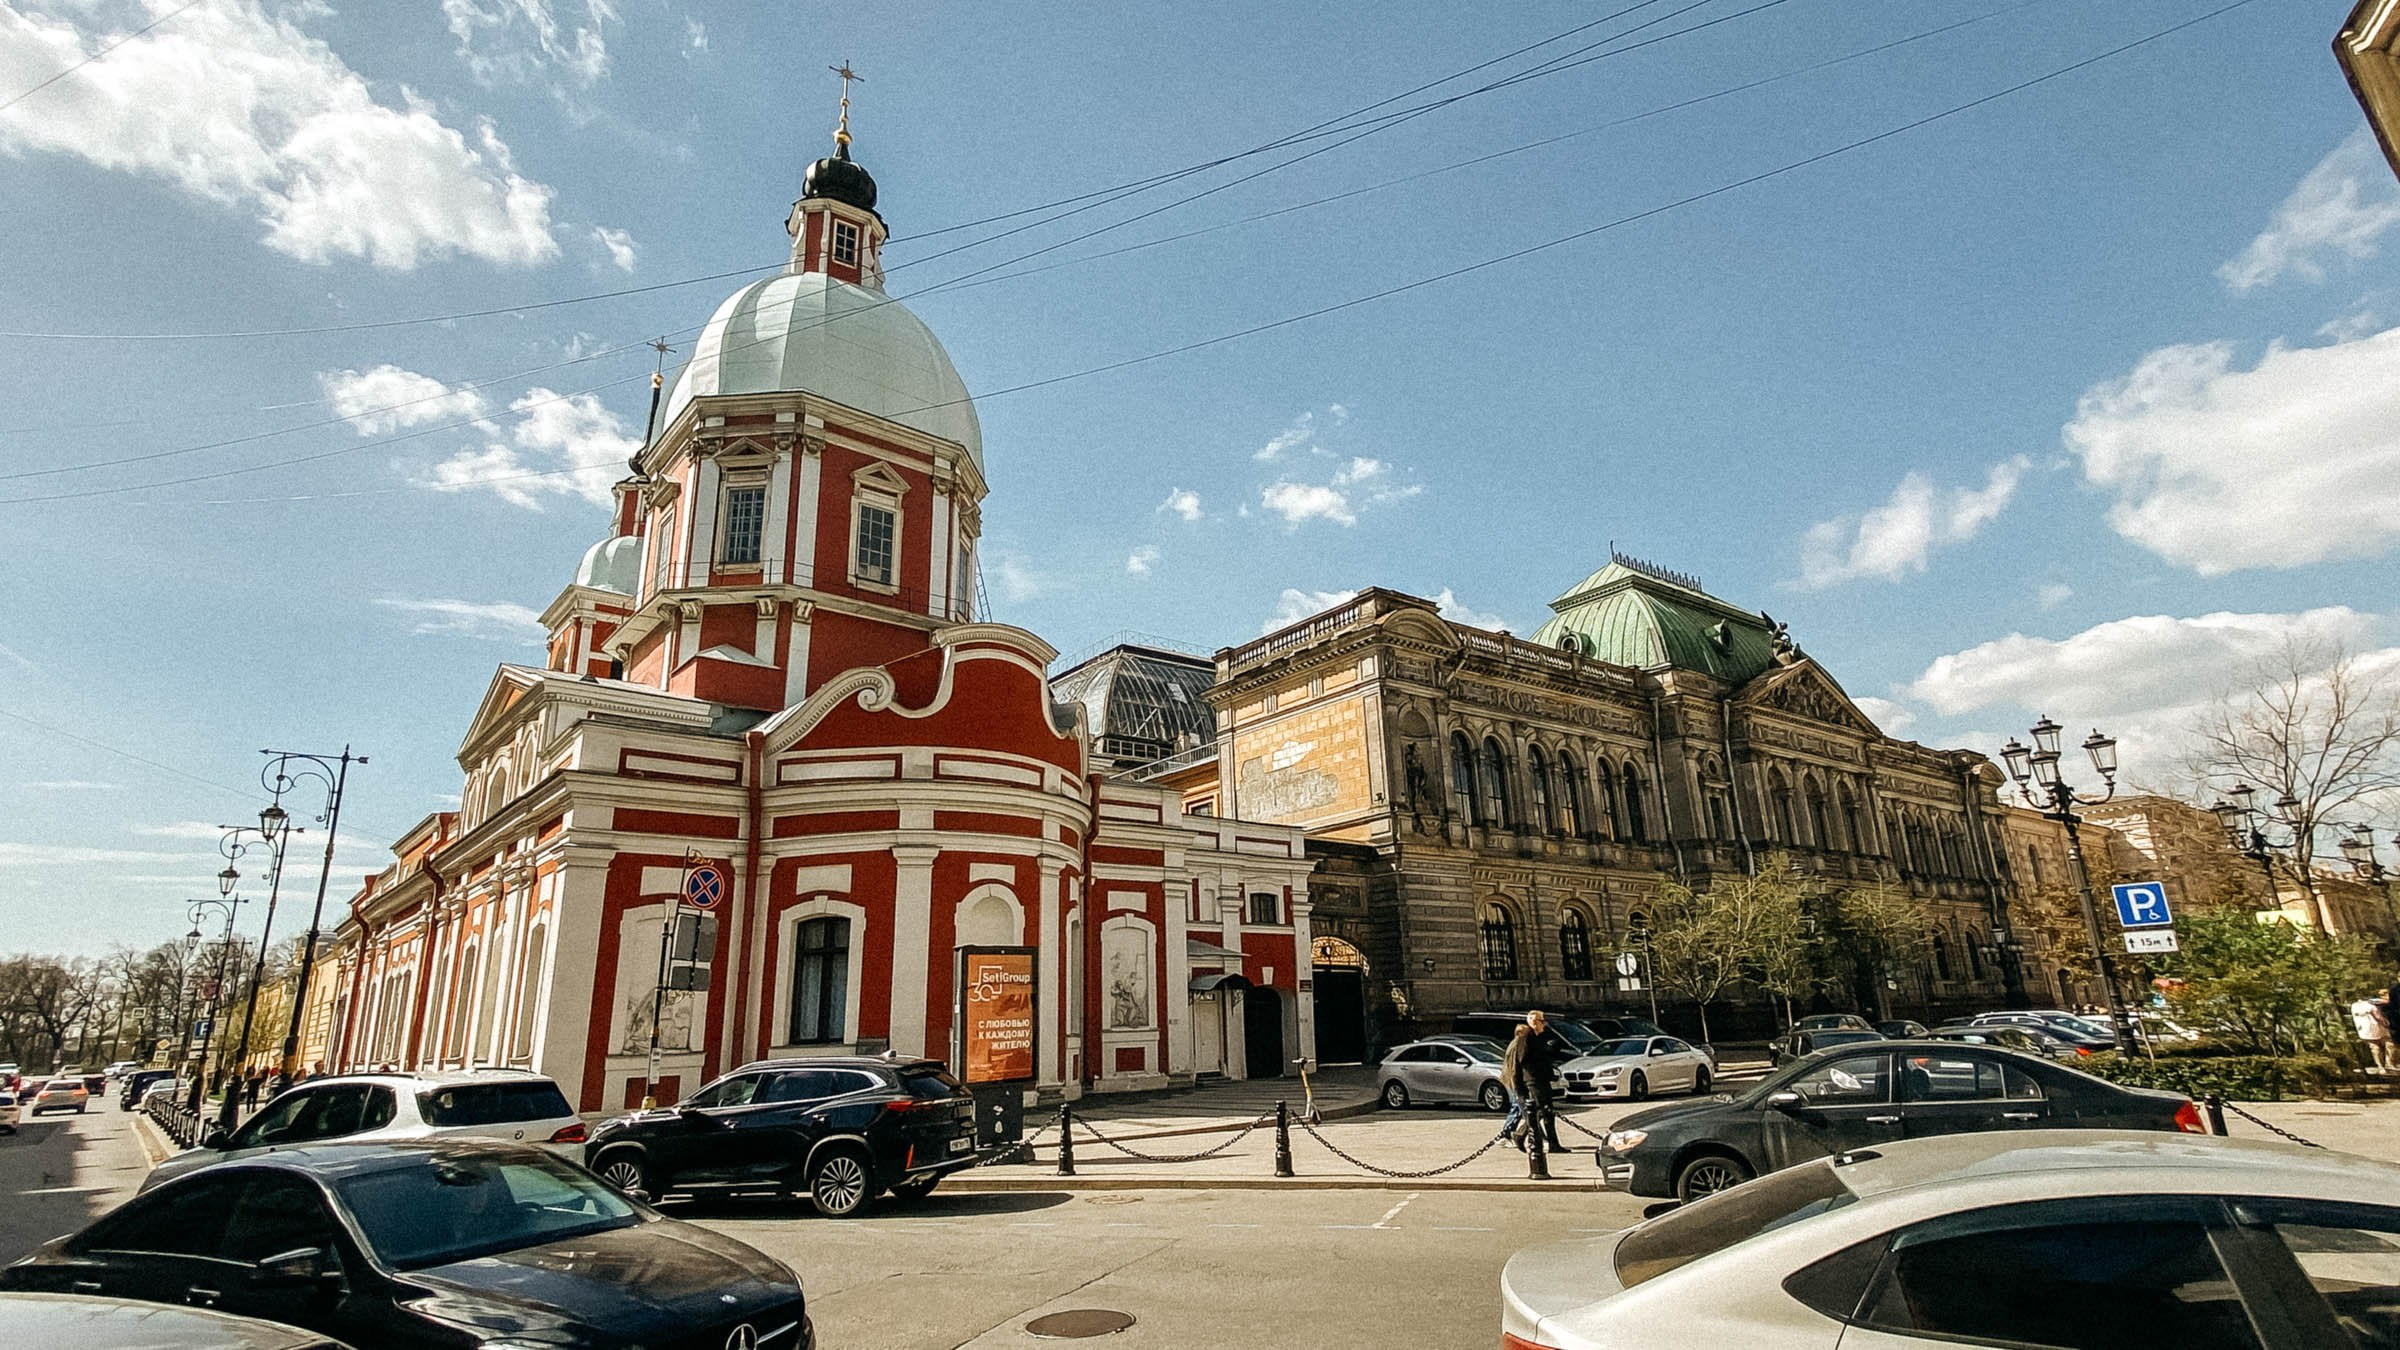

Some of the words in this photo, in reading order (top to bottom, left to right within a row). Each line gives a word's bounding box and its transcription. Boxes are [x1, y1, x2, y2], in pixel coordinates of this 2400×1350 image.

[2127, 888, 2156, 921] P
[978, 1021, 985, 1029] С
[986, 1019, 1030, 1029] ЛЮБОВЬЮ
[978, 1031, 985, 1039] К
[986, 1029, 1031, 1040] КАЖДОМУ
[991, 1040, 1030, 1050] ЖИТЕЛЮ
